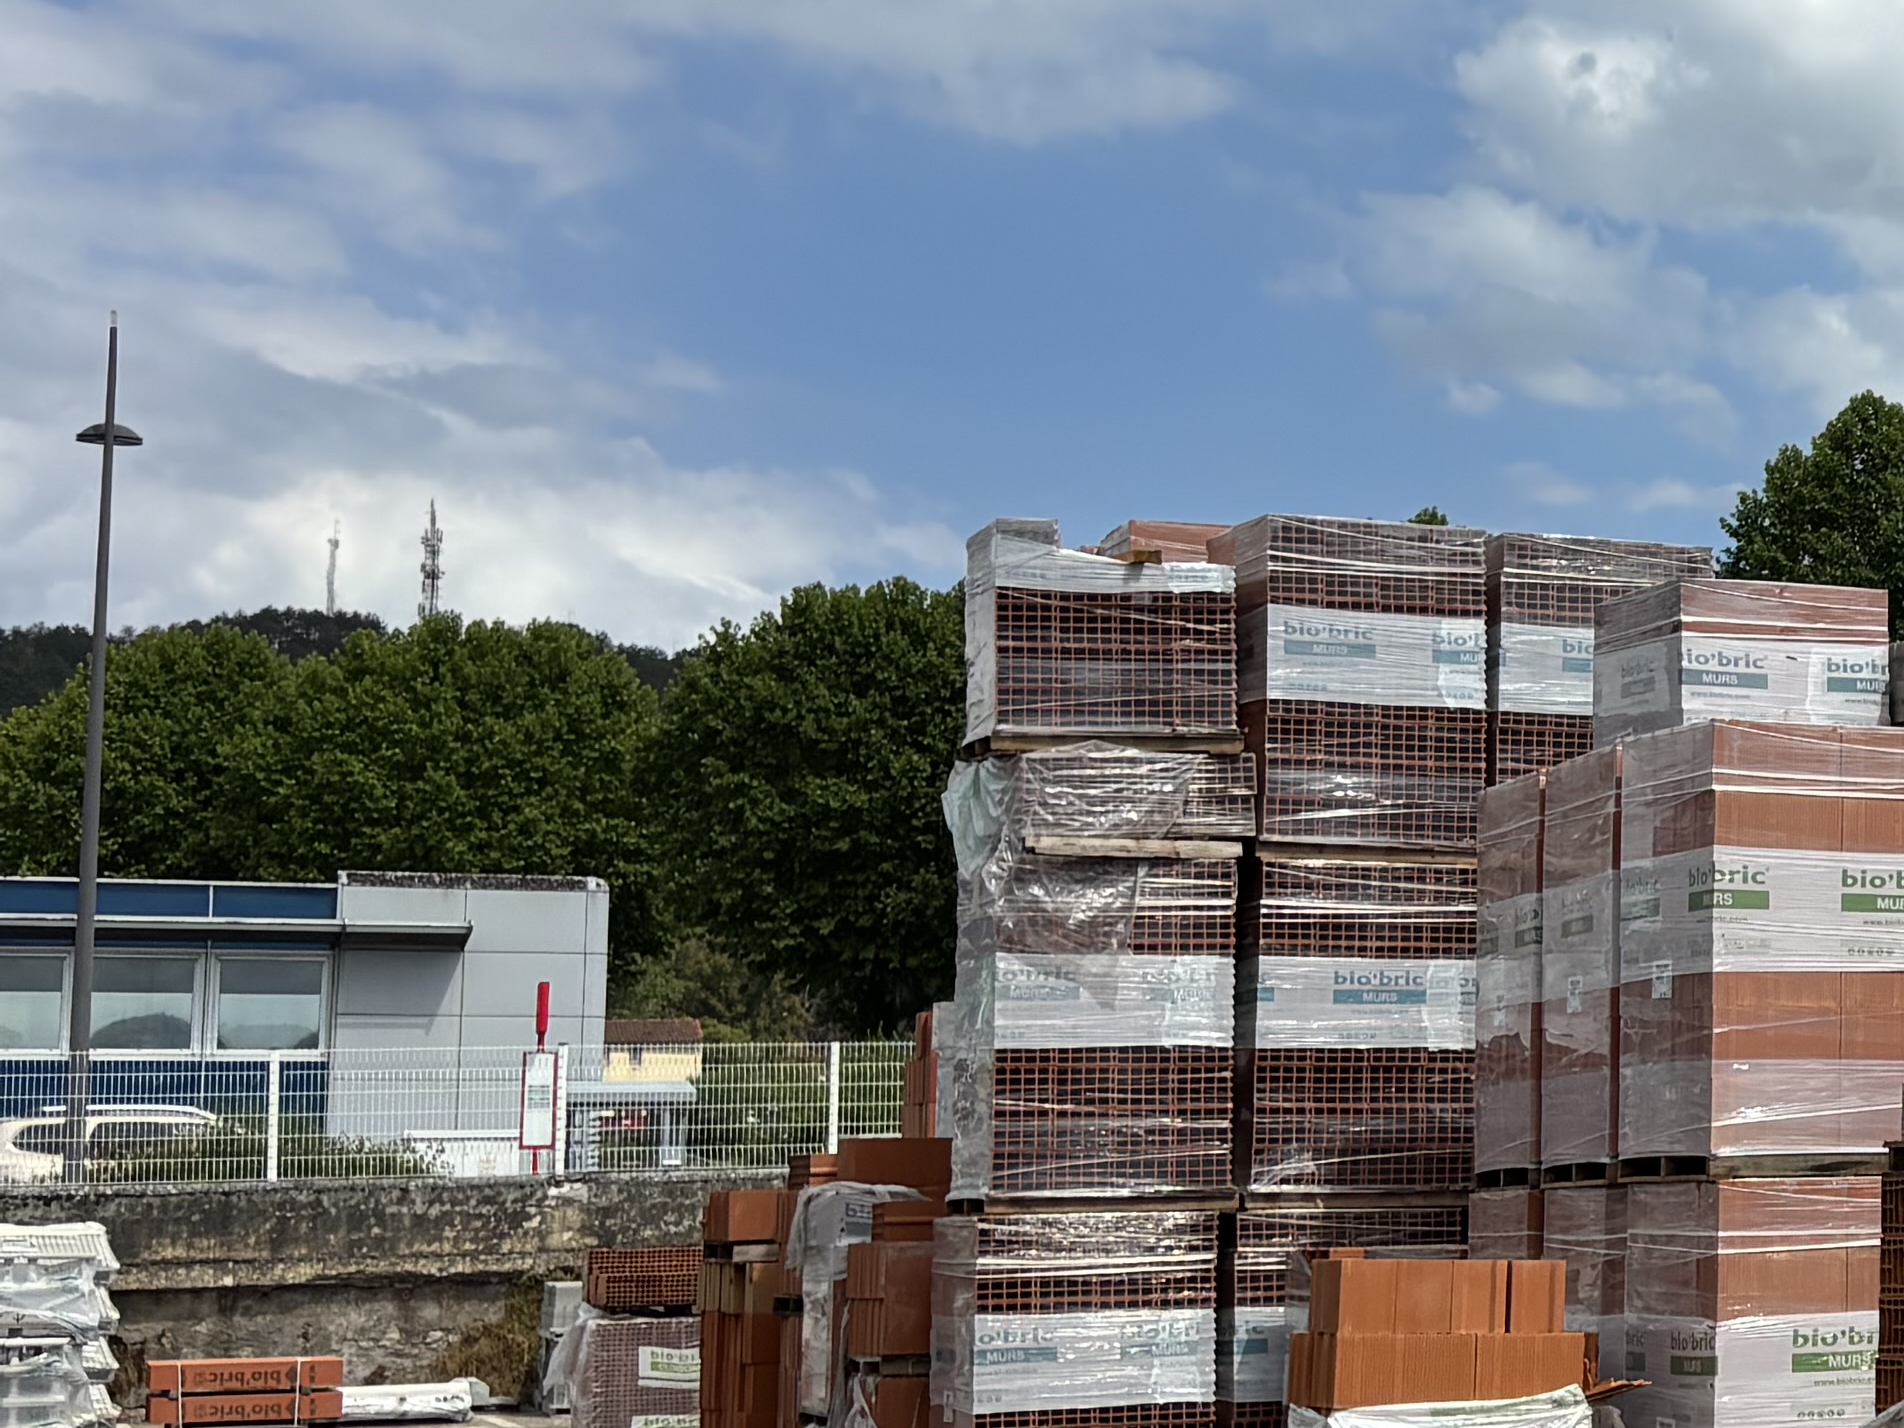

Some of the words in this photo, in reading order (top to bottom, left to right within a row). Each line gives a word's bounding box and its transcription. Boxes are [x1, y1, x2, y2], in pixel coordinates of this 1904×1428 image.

[1701, 672, 1738, 686] MURS
[1362, 991, 1399, 1003] MURS
[1828, 1352, 1872, 1368] MURS
